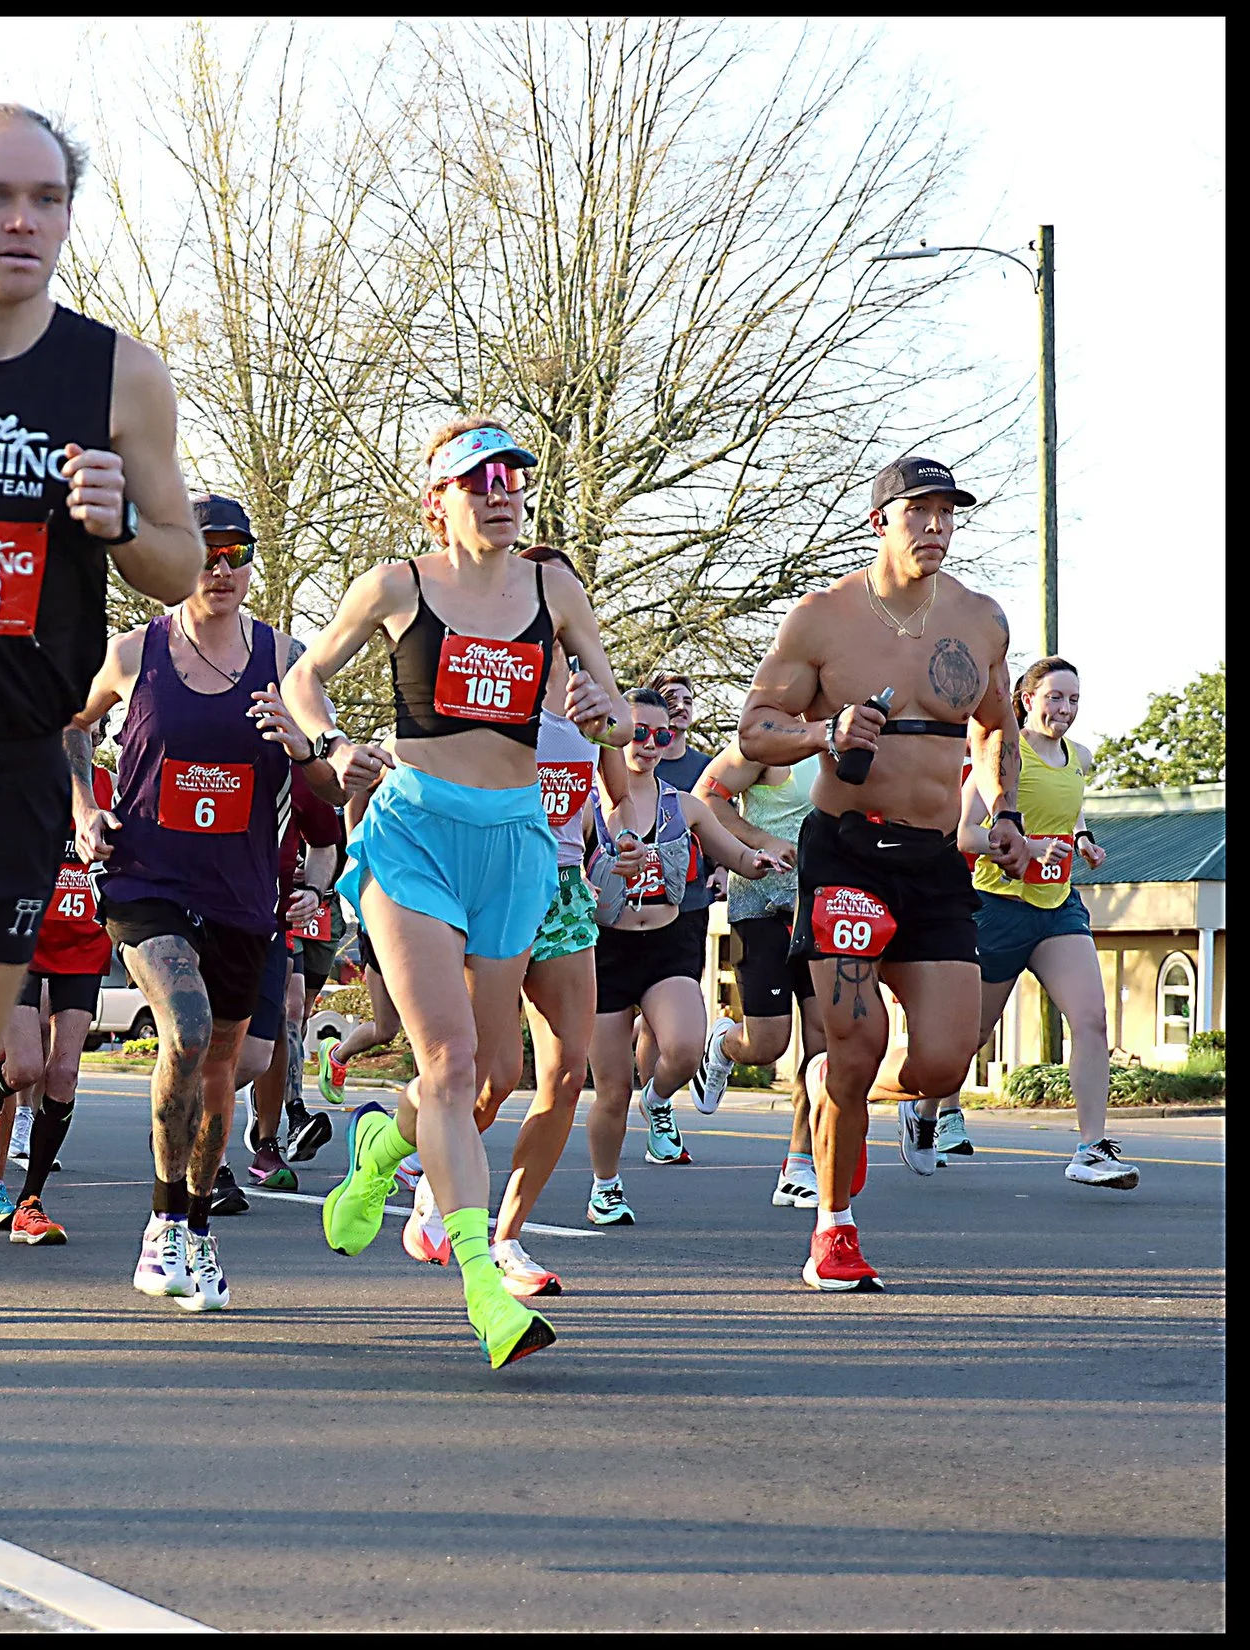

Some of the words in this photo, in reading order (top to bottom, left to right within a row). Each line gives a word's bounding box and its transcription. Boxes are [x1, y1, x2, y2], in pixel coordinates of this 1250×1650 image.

[465, 643, 523, 667] Strictly
[448, 655, 534, 682] RUNNING
[465, 676, 511, 709] 105
[175, 773, 241, 789] RUNNING
[186, 764, 231, 778] Strictly
[538, 766, 579, 780] Strictly
[194, 797, 216, 828] 6
[57, 892, 86, 918] 45
[826, 898, 885, 915] RUNNING
[833, 888, 875, 903] Strictly
[833, 919, 872, 951] 69
